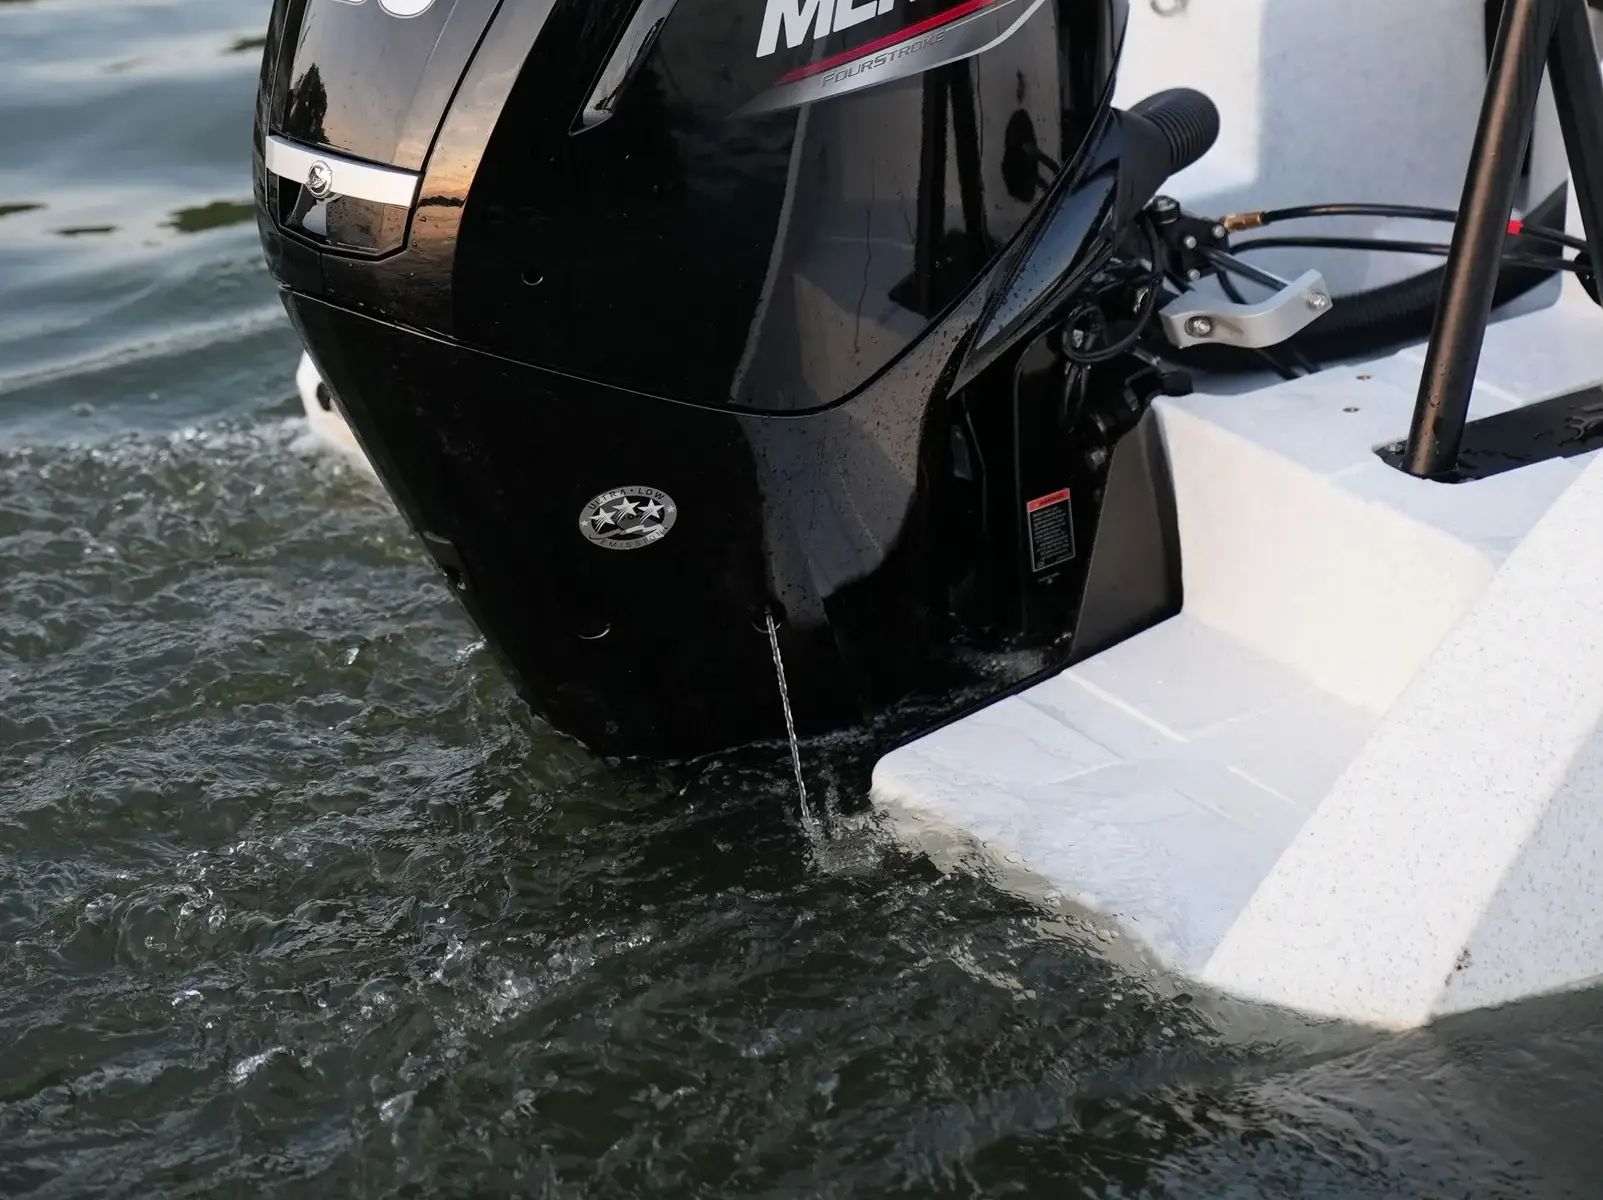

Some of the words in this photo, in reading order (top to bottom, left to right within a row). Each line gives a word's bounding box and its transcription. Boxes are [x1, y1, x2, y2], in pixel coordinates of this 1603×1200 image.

[820, 31, 945, 87] FOURSTROKE
[588, 488, 627, 510] ULTRA
[638, 487, 665, 500] LOW
